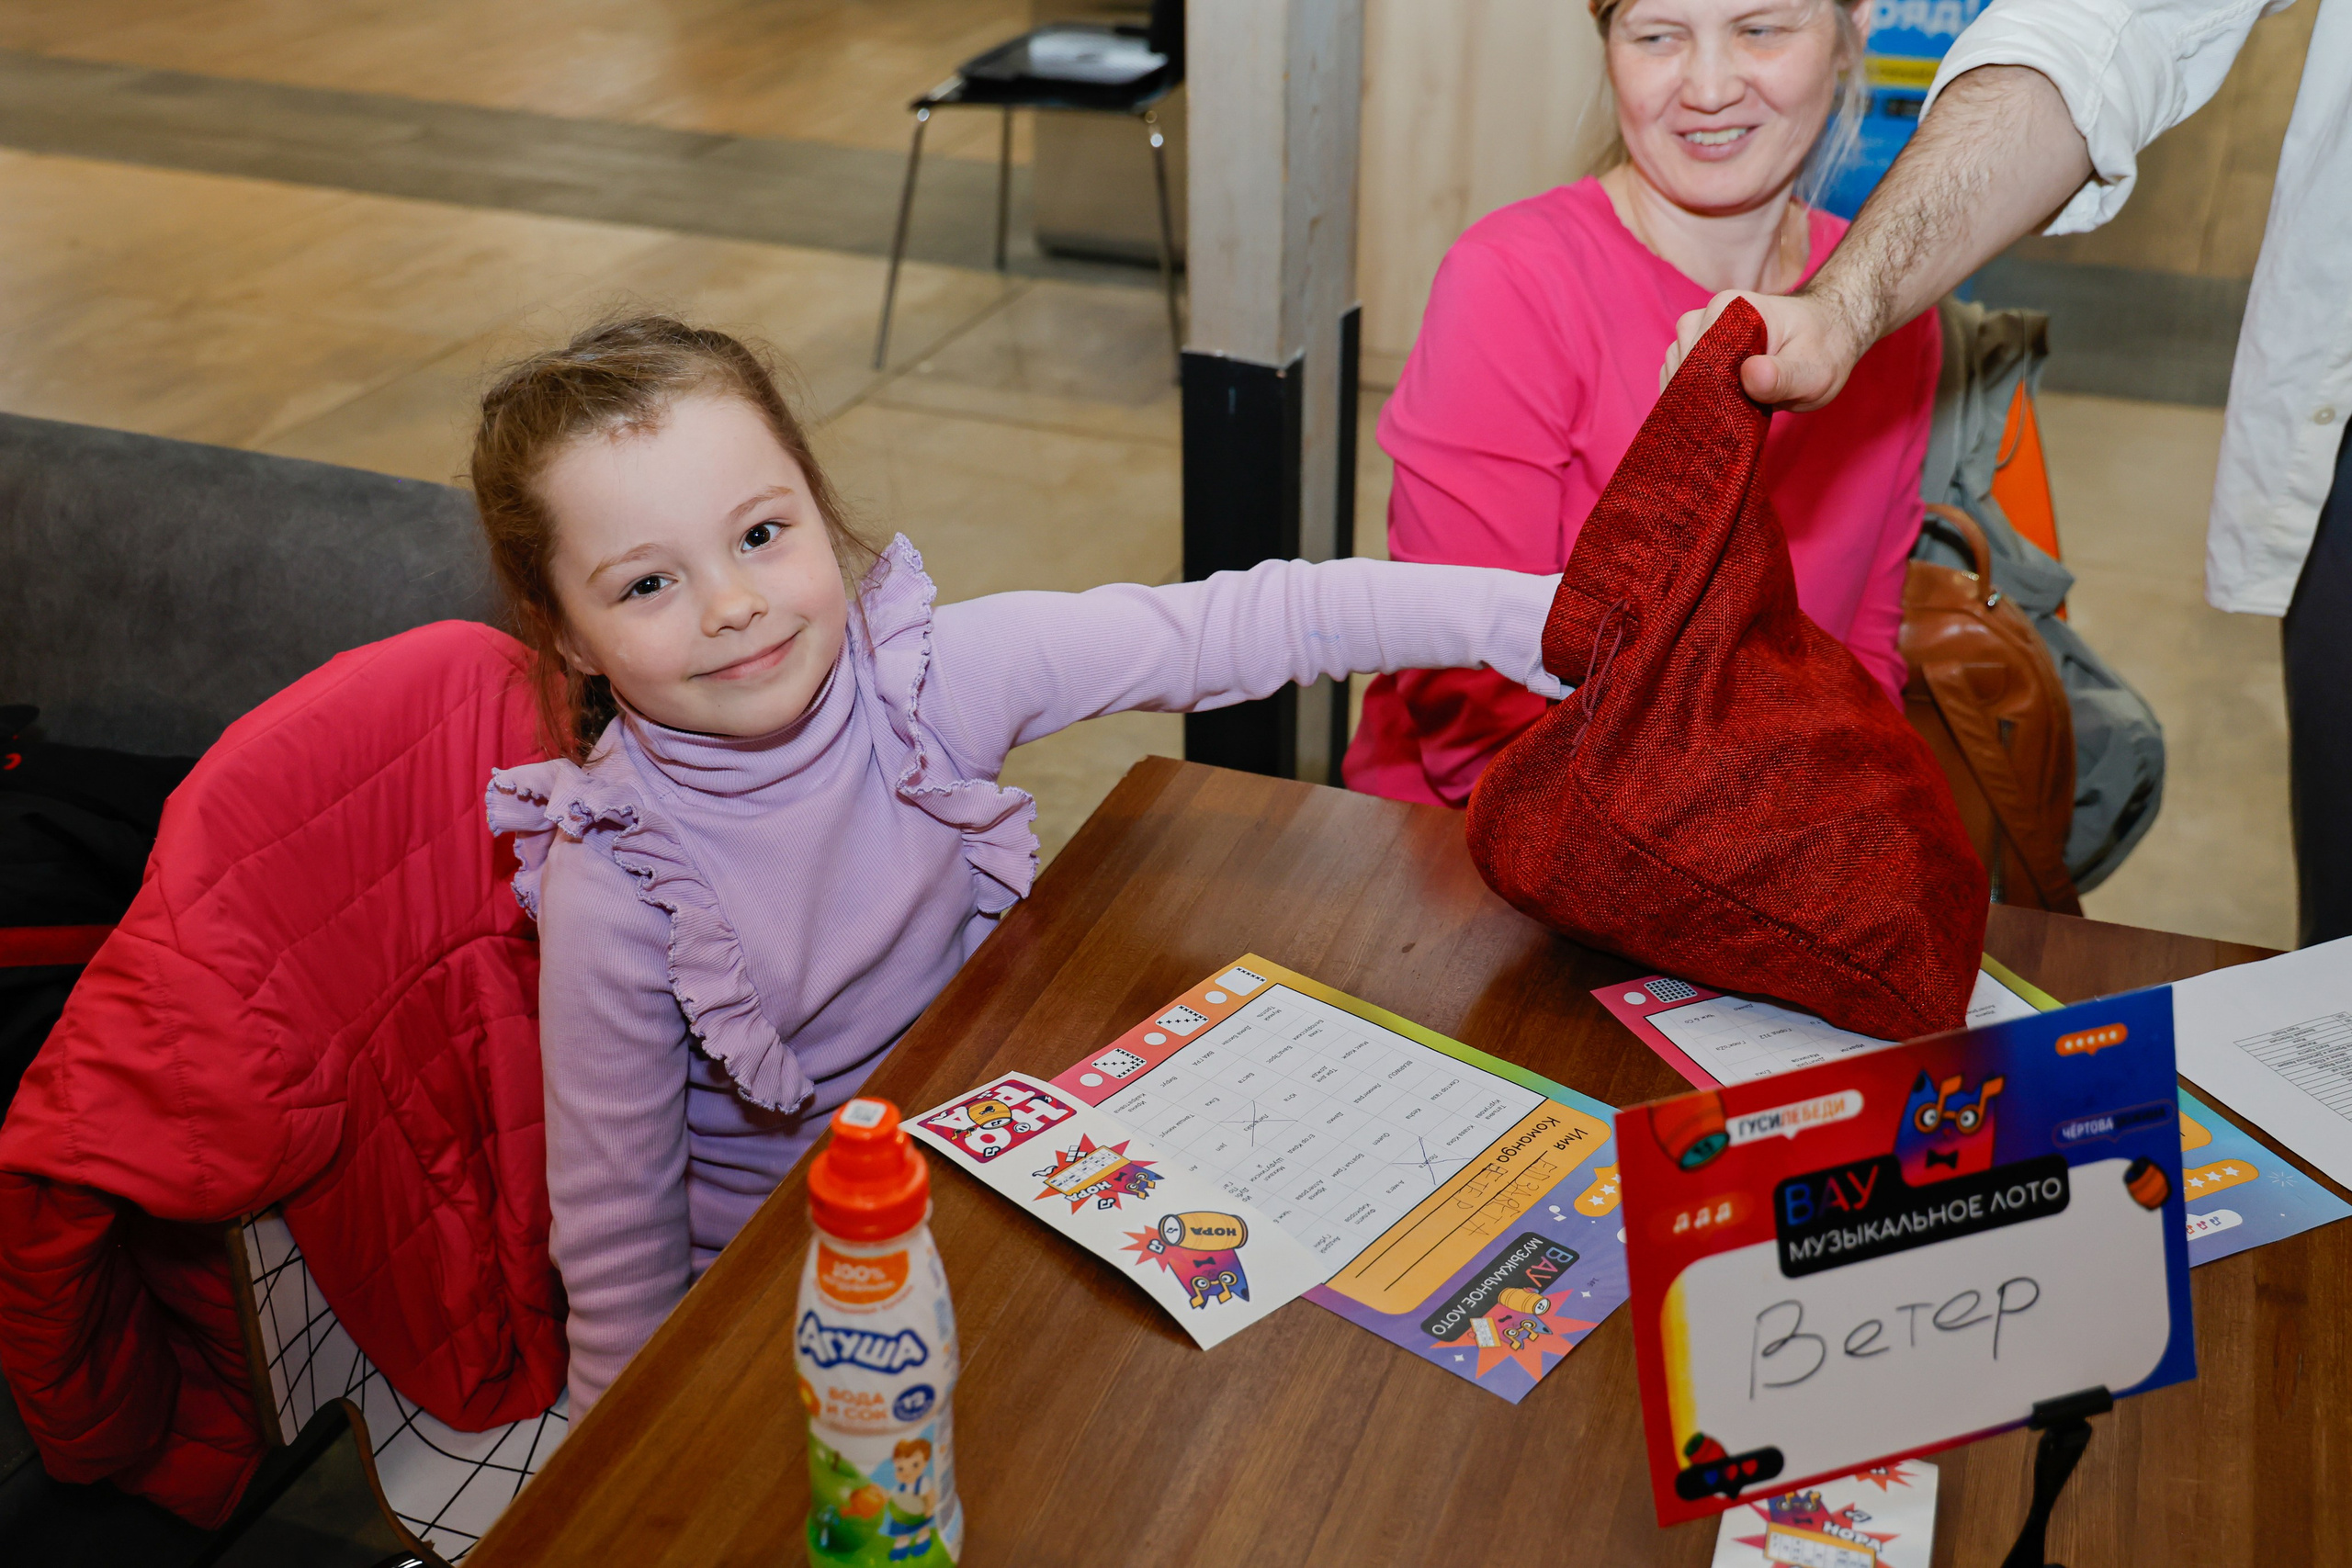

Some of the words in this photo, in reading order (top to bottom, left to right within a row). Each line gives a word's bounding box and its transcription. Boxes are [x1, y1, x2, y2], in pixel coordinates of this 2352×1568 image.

[1256, 1005, 1276, 1018] Тролль
[1263, 1009, 1282, 1021] Мумий
[1236, 1025, 1252, 1035] Дима
[1292, 1019, 1324, 1041] Белорусских
[1307, 1028, 1323, 1037] Тима
[1771, 1027, 1792, 1036] Город
[1221, 1034, 1239, 1045] Билан
[1354, 1041, 1369, 1050] Макс
[1201, 1050, 1215, 1059] ВИА
[1341, 1049, 1356, 1059] Корж
[1791, 1053, 1821, 1063] Маликов
[1192, 1057, 1204, 1066] ГРА
[1311, 1065, 1328, 1078] дождя
[1326, 1068, 1338, 1077] Три
[1387, 1060, 1413, 1079] BEARWOLF
[1159, 1076, 1178, 1088] Вирус
[1238, 1072, 1255, 1084] Баста
[1316, 1074, 1327, 1083] дня
[1441, 1078, 1460, 1093] Сектор
[1283, 1092, 1297, 1102] Юта
[1352, 1082, 1382, 1104] Ленинград
[1430, 1091, 1443, 1100] газа
[1127, 1100, 1147, 1112] Ирина
[1485, 1104, 1507, 1120] Татьяна
[1175, 1113, 1195, 1126] Танцы
[1326, 1111, 1344, 1124] Данко
[1159, 1125, 1177, 1138] минус
[1457, 1124, 1475, 1136] Клава
[1301, 1134, 1316, 1144] Егор
[1372, 1133, 1390, 1145] Queen
[1446, 1135, 1460, 1146] Кока
[1496, 1115, 1561, 1163] Команда
[1554, 1127, 1589, 1151] Имя
[1287, 1143, 1303, 1154] Крид
[1344, 1153, 1365, 1168] Братья
[1250, 1156, 1284, 1182] Шуфутински
[1263, 1166, 1285, 1181] Михаил
[1331, 1167, 1347, 1178] Грим
[1065, 1180, 1113, 1202] НОРА
[1295, 1179, 1324, 1201] Аллегрова
[1307, 1187, 1327, 1201] Ирина
[1784, 1164, 1880, 1224] ВАУ
[1344, 1202, 1370, 1223] Киркоров
[1354, 1208, 1376, 1224] Филипп
[1788, 1194, 1984, 1264] МУЗЫКАЛЬНОЕ
[1990, 1176, 2063, 1212] ЛОТО
[1190, 1227, 1237, 1236] НОРА
[1313, 1234, 1332, 1248] Губин
[1319, 1235, 1340, 1254] Андрей
[1466, 1237, 1544, 1308] МУЗЫКАЛЬНОЕ
[1525, 1247, 1573, 1287] ВАУ
[1431, 1304, 1466, 1336] ЛОТО
[1749, 1277, 2041, 1400] Ветер
[828, 1386, 885, 1406] ВОДА
[1823, 1520, 1883, 1555] НОРА
